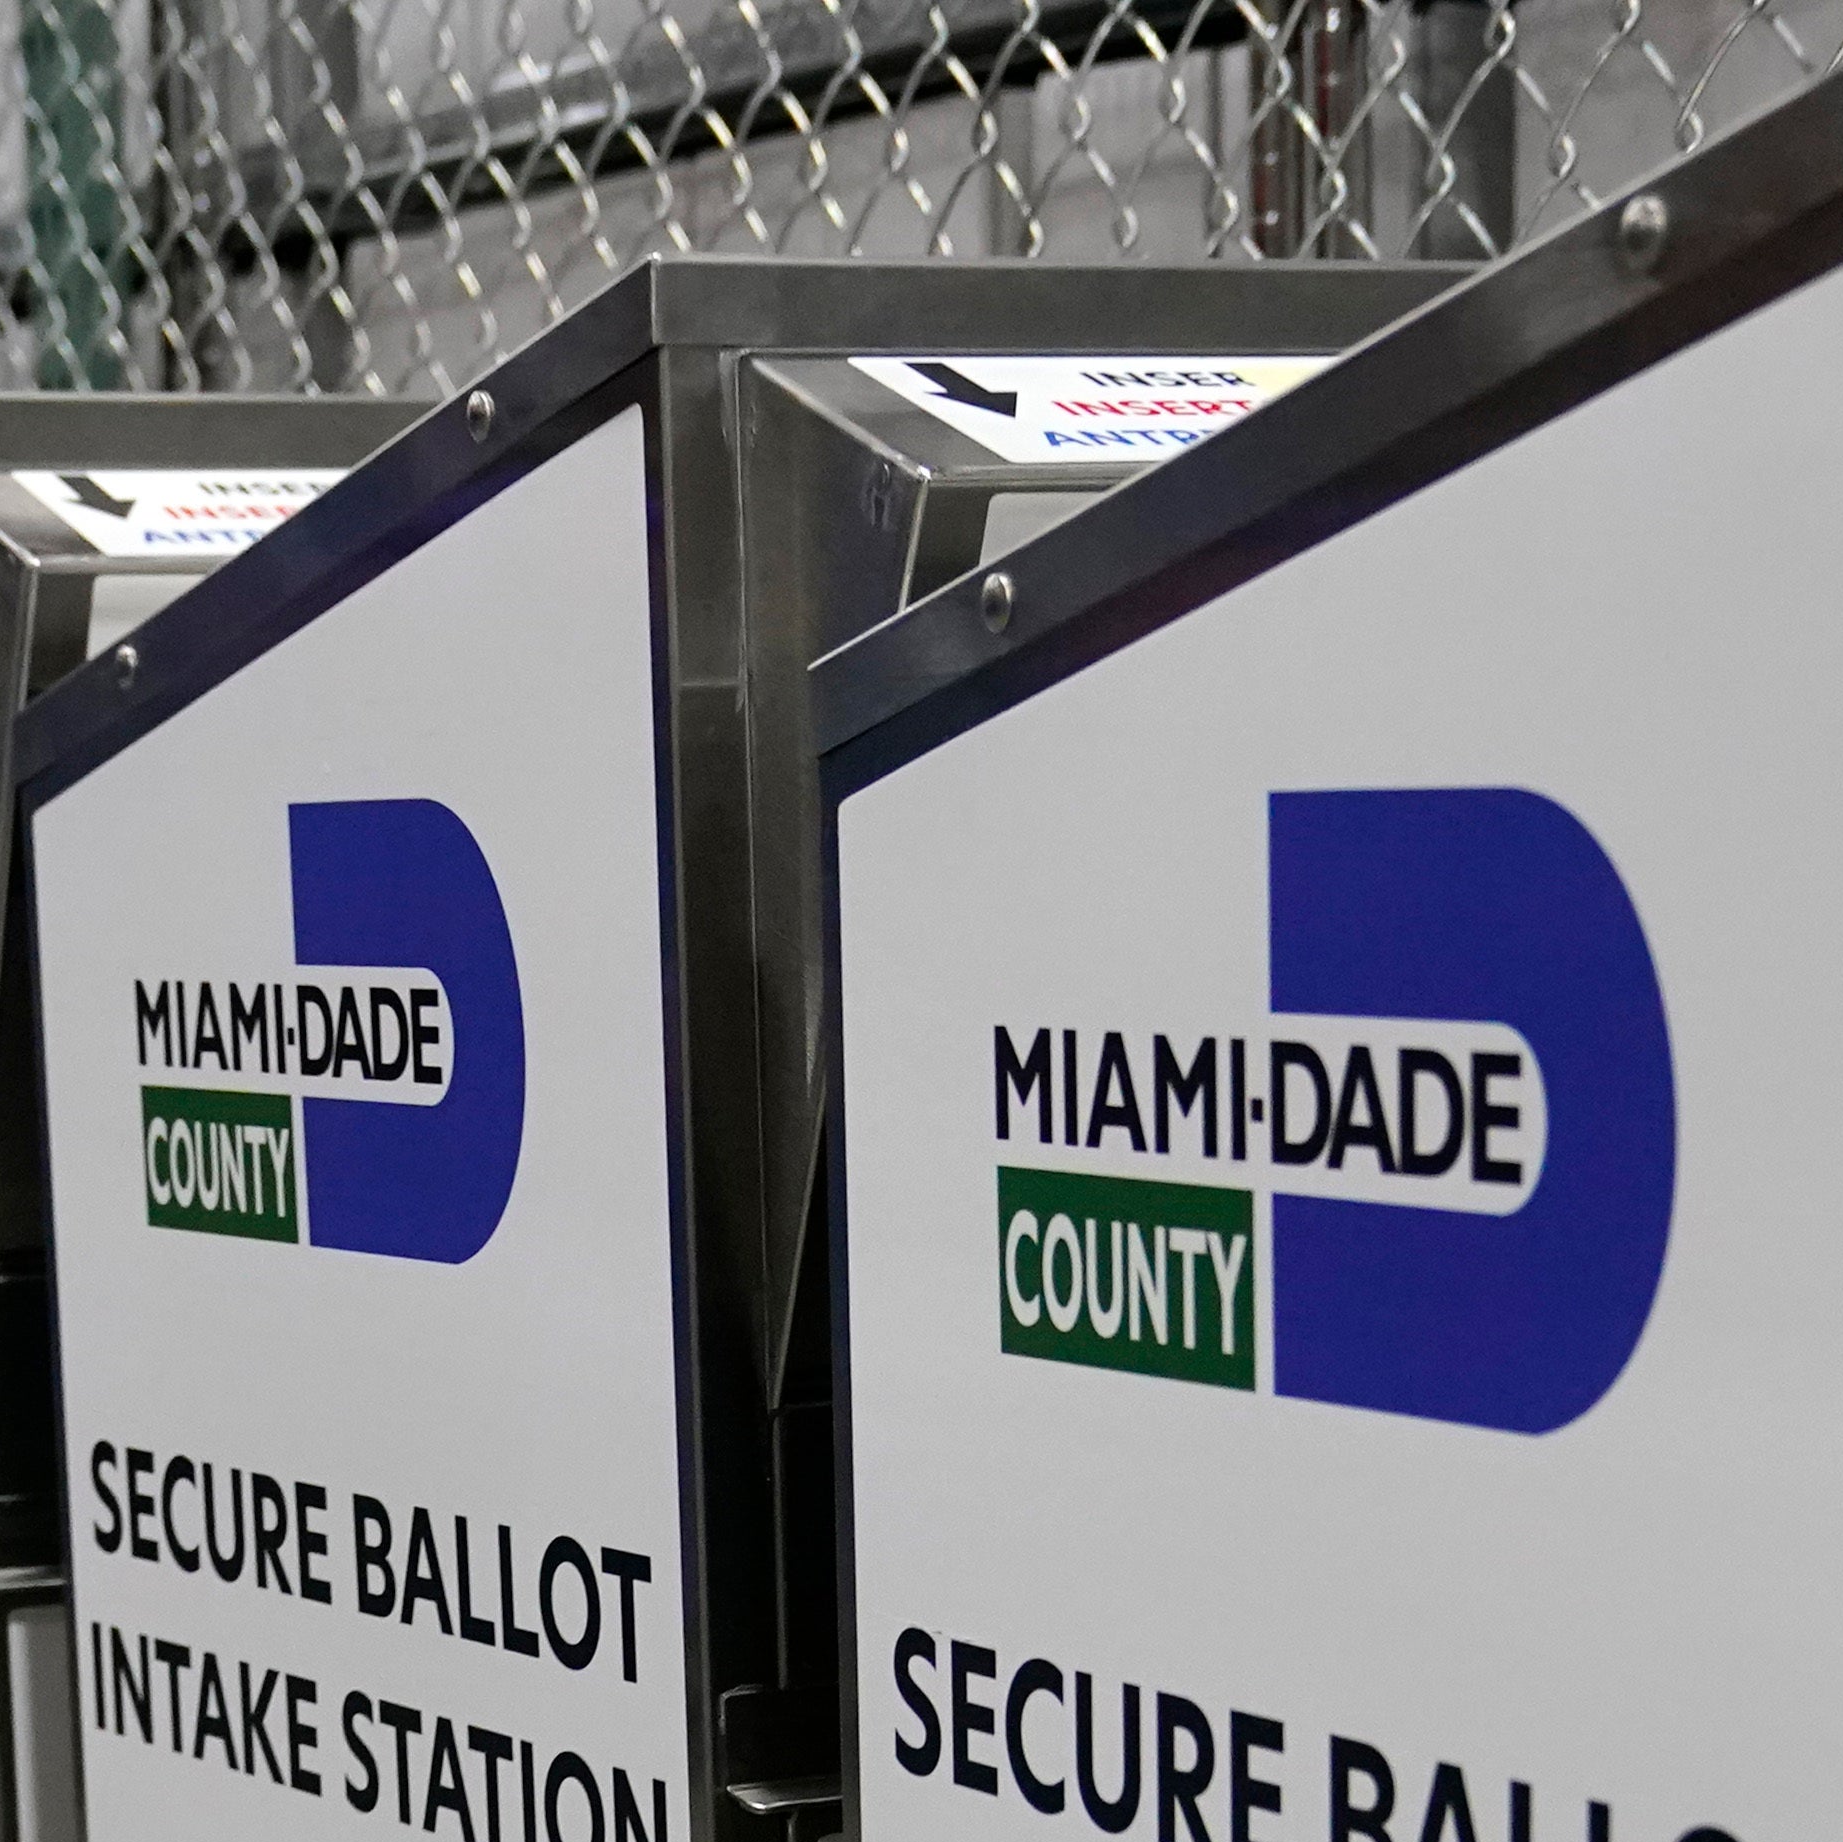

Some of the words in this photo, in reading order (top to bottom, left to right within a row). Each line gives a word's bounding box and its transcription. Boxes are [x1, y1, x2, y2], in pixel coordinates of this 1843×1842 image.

[1044, 430, 1214, 446] ANTR
[134, 978, 444, 1085] MIAMI-DADE
[994, 1025, 1524, 1186] MIAMI-DADE
[147, 1117, 290, 1218] COUNTY
[1005, 1208, 1249, 1356] COUNTY
[91, 1440, 332, 1604] SECURE
[353, 1494, 651, 1683] BALLOT
[92, 1622, 321, 1796] INTAKE
